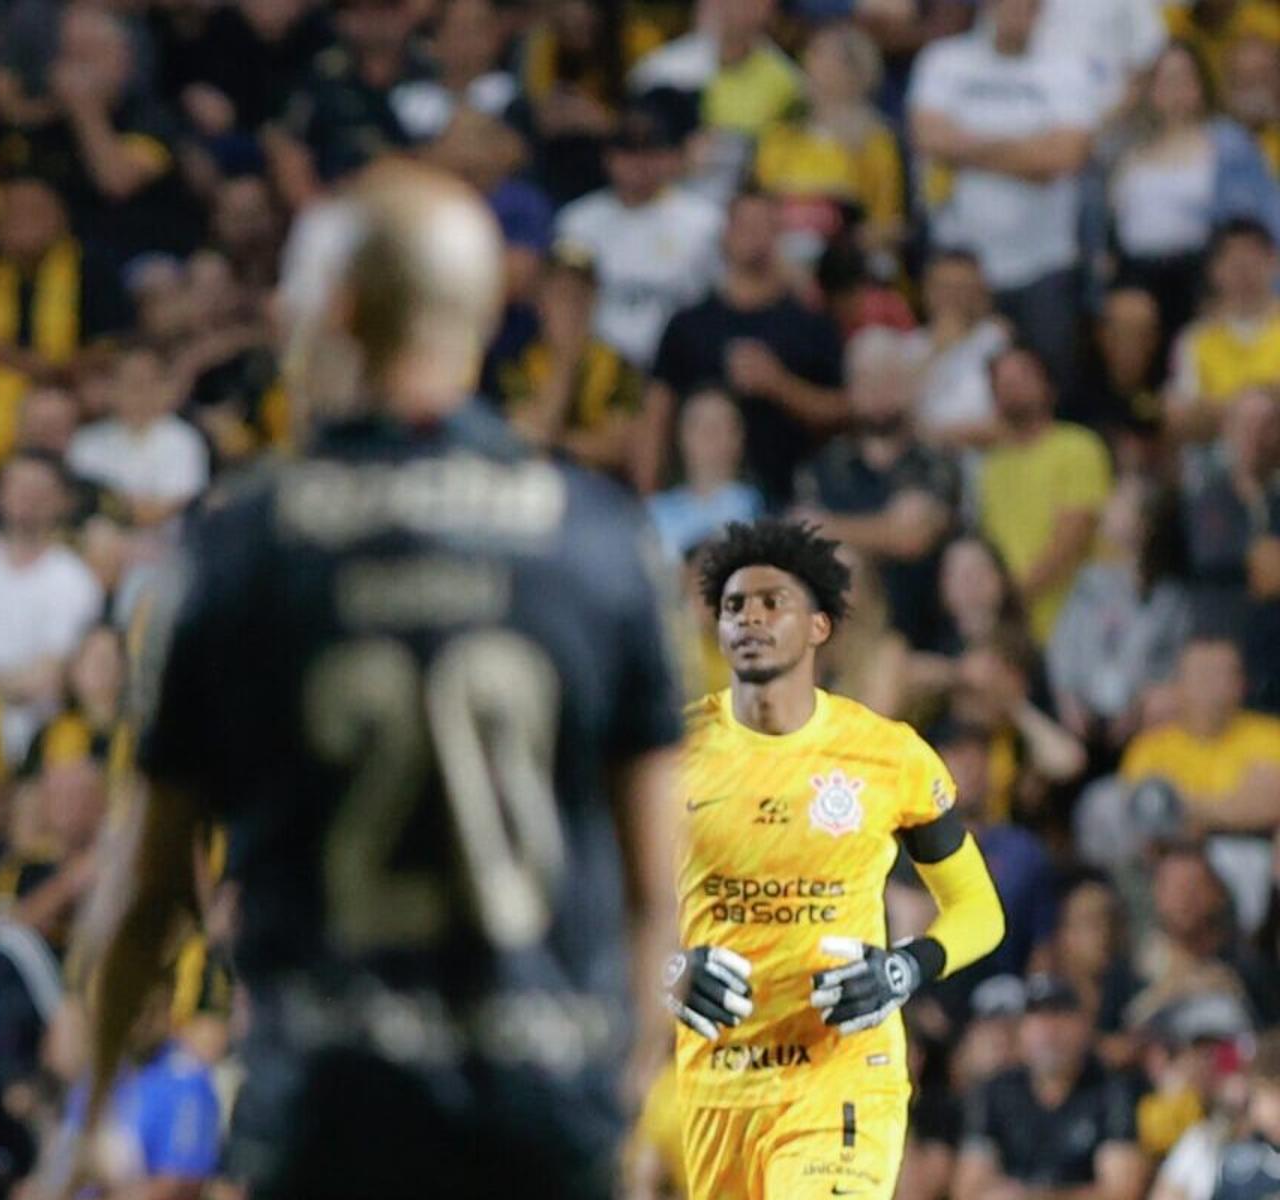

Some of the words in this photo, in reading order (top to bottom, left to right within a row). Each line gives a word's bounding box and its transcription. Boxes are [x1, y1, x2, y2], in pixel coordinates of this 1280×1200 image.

[304, 629, 567, 951] 20
[704, 874, 846, 905] Esportes
[750, 902, 838, 924] Sorte
[711, 1044, 811, 1070] FOXLUX
[842, 1101, 856, 1147] 1
